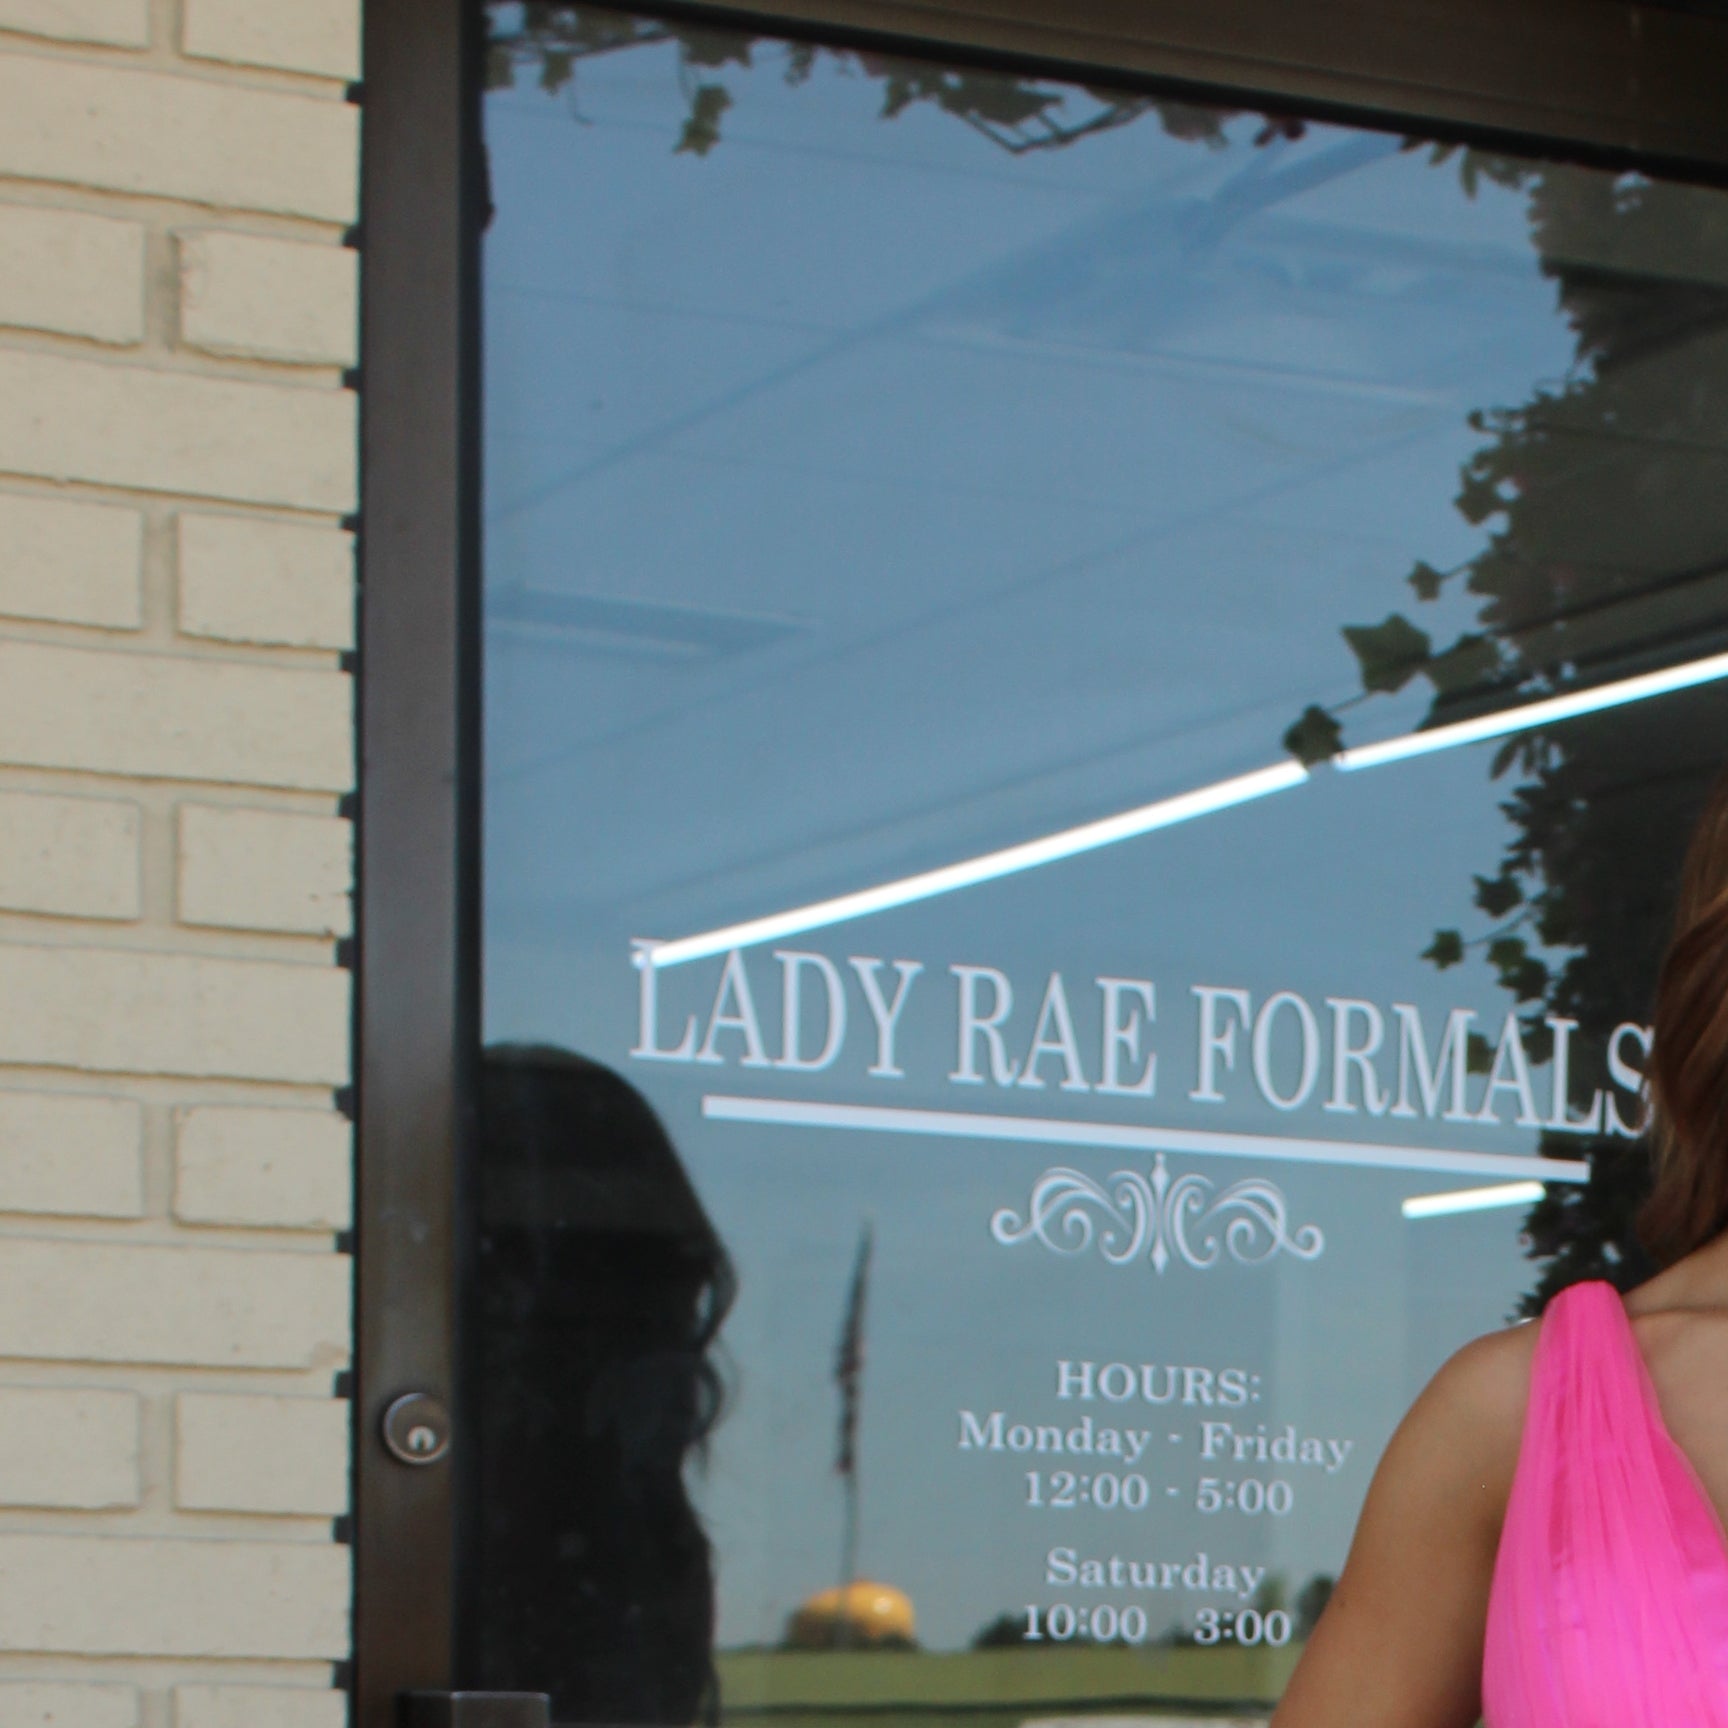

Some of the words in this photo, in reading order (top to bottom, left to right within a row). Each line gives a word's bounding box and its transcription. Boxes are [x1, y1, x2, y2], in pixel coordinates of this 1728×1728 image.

[629, 938, 923, 1078] LADY
[948, 963, 1157, 1098] RAE
[1188, 984, 1655, 1139] FORMALS
[1056, 1360, 1262, 1407] HOURS:
[957, 1410, 1151, 1464] Monday
[1201, 1421, 1353, 1472] Friday
[1024, 1470, 1150, 1510] 12:00
[1195, 1476, 1294, 1516] 5:00
[1045, 1546, 1266, 1598] Saturday
[1023, 1604, 1148, 1643] 10:00
[1193, 1608, 1292, 1646] 3:00
